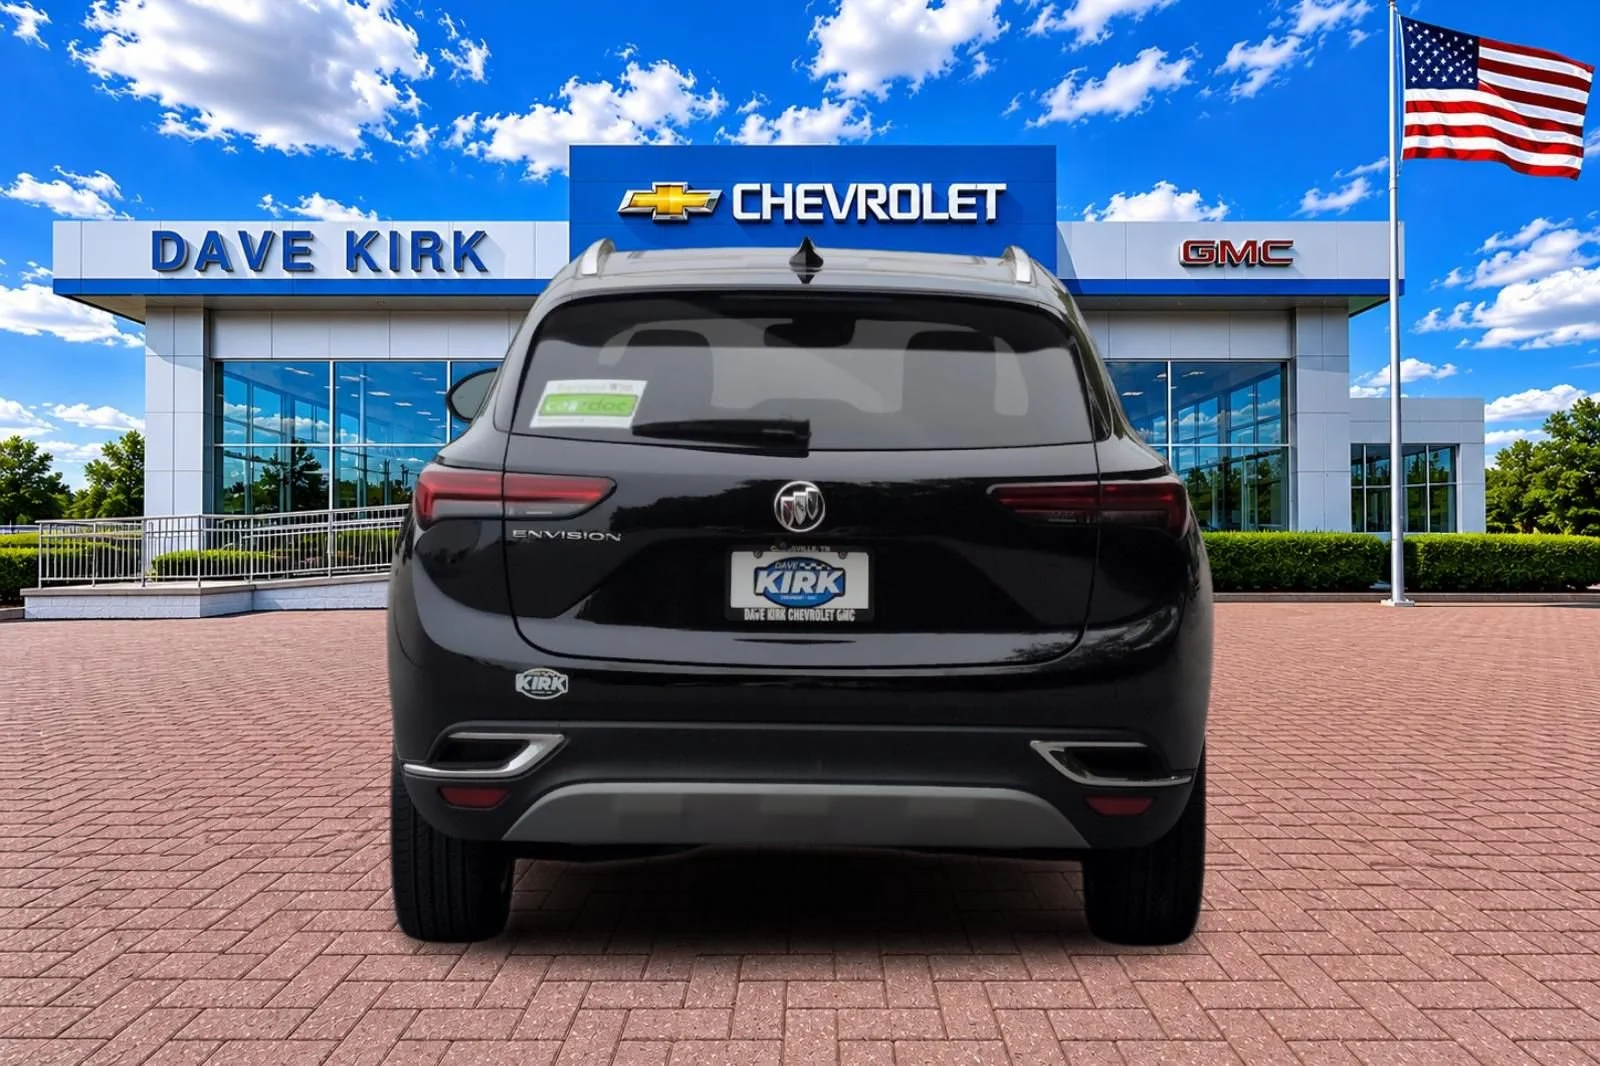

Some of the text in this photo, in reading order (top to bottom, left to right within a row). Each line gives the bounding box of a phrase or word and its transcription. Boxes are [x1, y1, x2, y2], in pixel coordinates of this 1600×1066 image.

[731, 182, 1008, 222] CHEVROLET
[151, 230, 489, 273] DAVE KIRK
[1179, 239, 1295, 268] GMC
[512, 529, 622, 542] ENVISION
[775, 561, 799, 570] DAVE
[755, 570, 844, 594] KIRK
[744, 608, 855, 621] DAVE KIRK CHEVROLET GMC
[518, 676, 566, 690] KIRK
